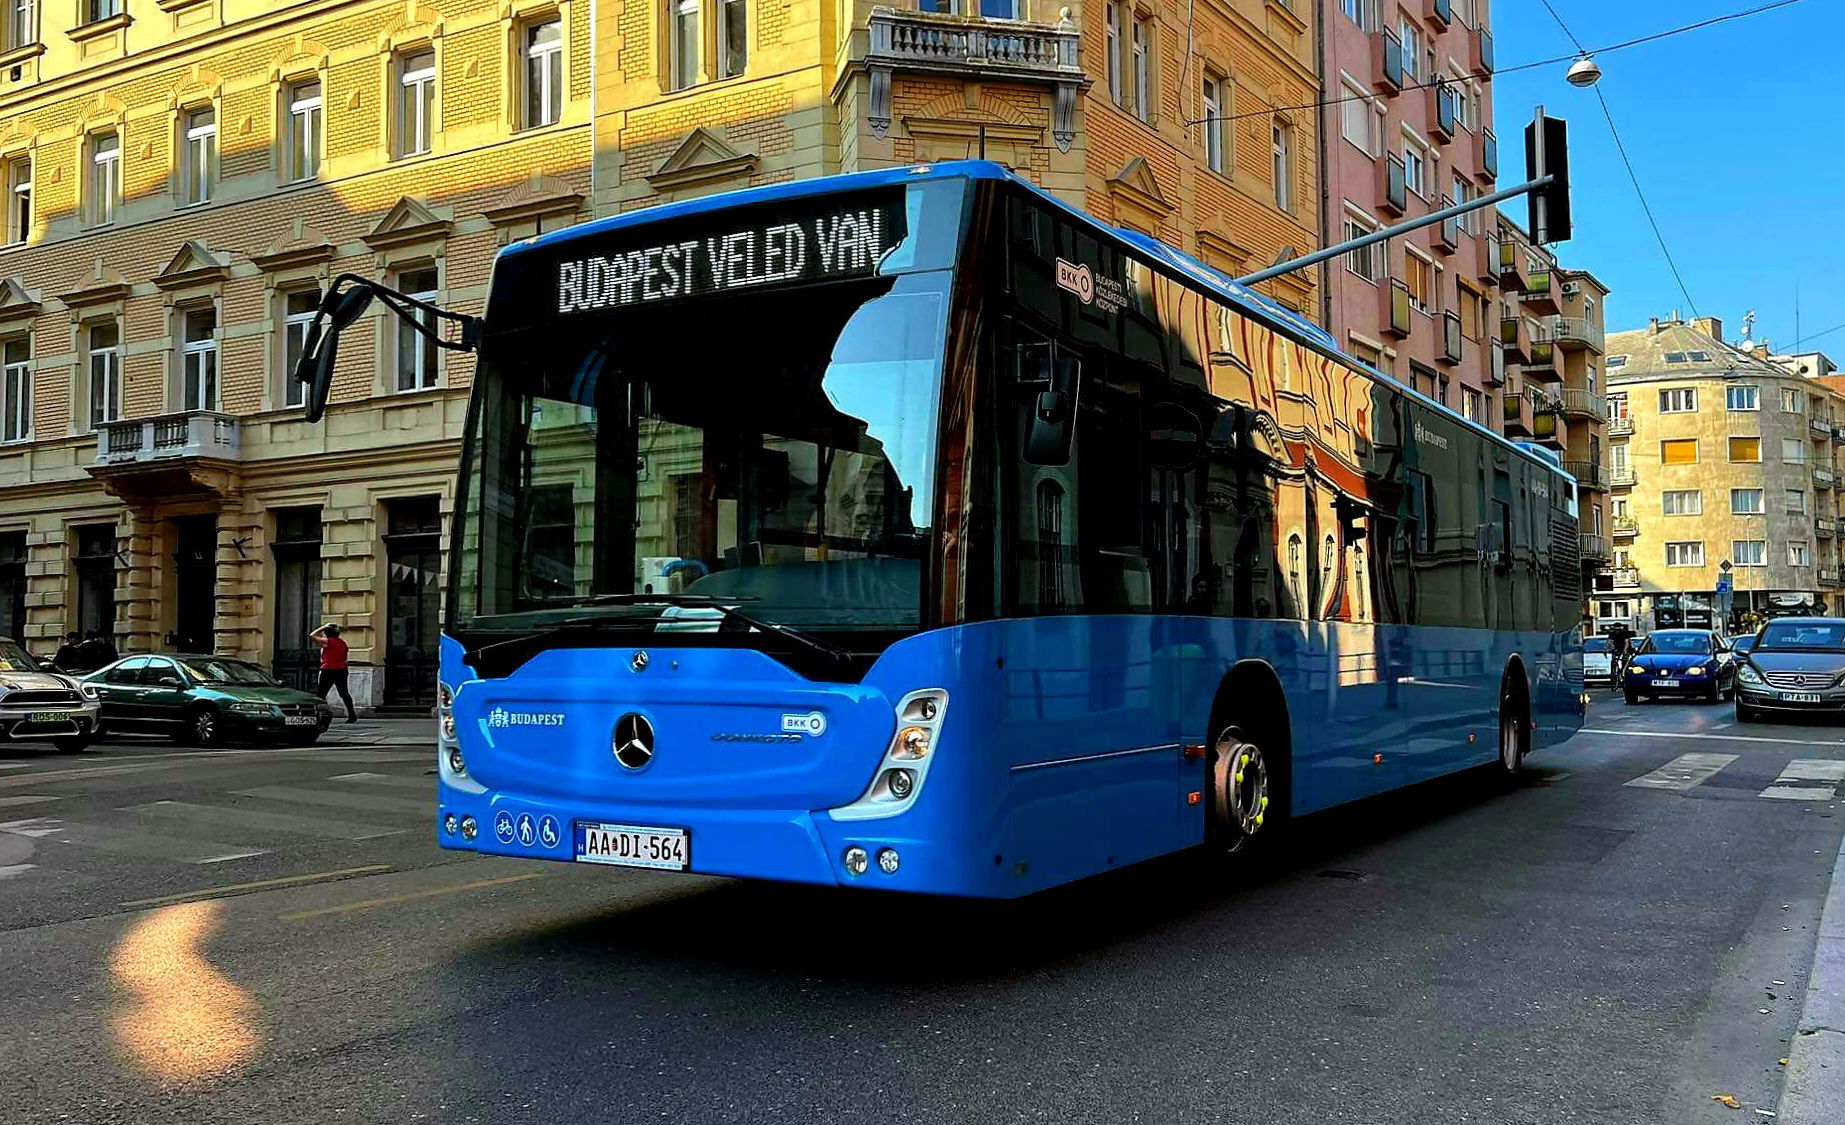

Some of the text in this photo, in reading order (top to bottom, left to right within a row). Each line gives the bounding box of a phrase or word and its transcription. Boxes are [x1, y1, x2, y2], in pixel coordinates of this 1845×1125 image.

[559, 208, 880, 313] BUDAPEST VELED VAN
[1061, 268, 1078, 286] BKK
[510, 713, 565, 726] BUDAPEST
[787, 719, 807, 728] BKK
